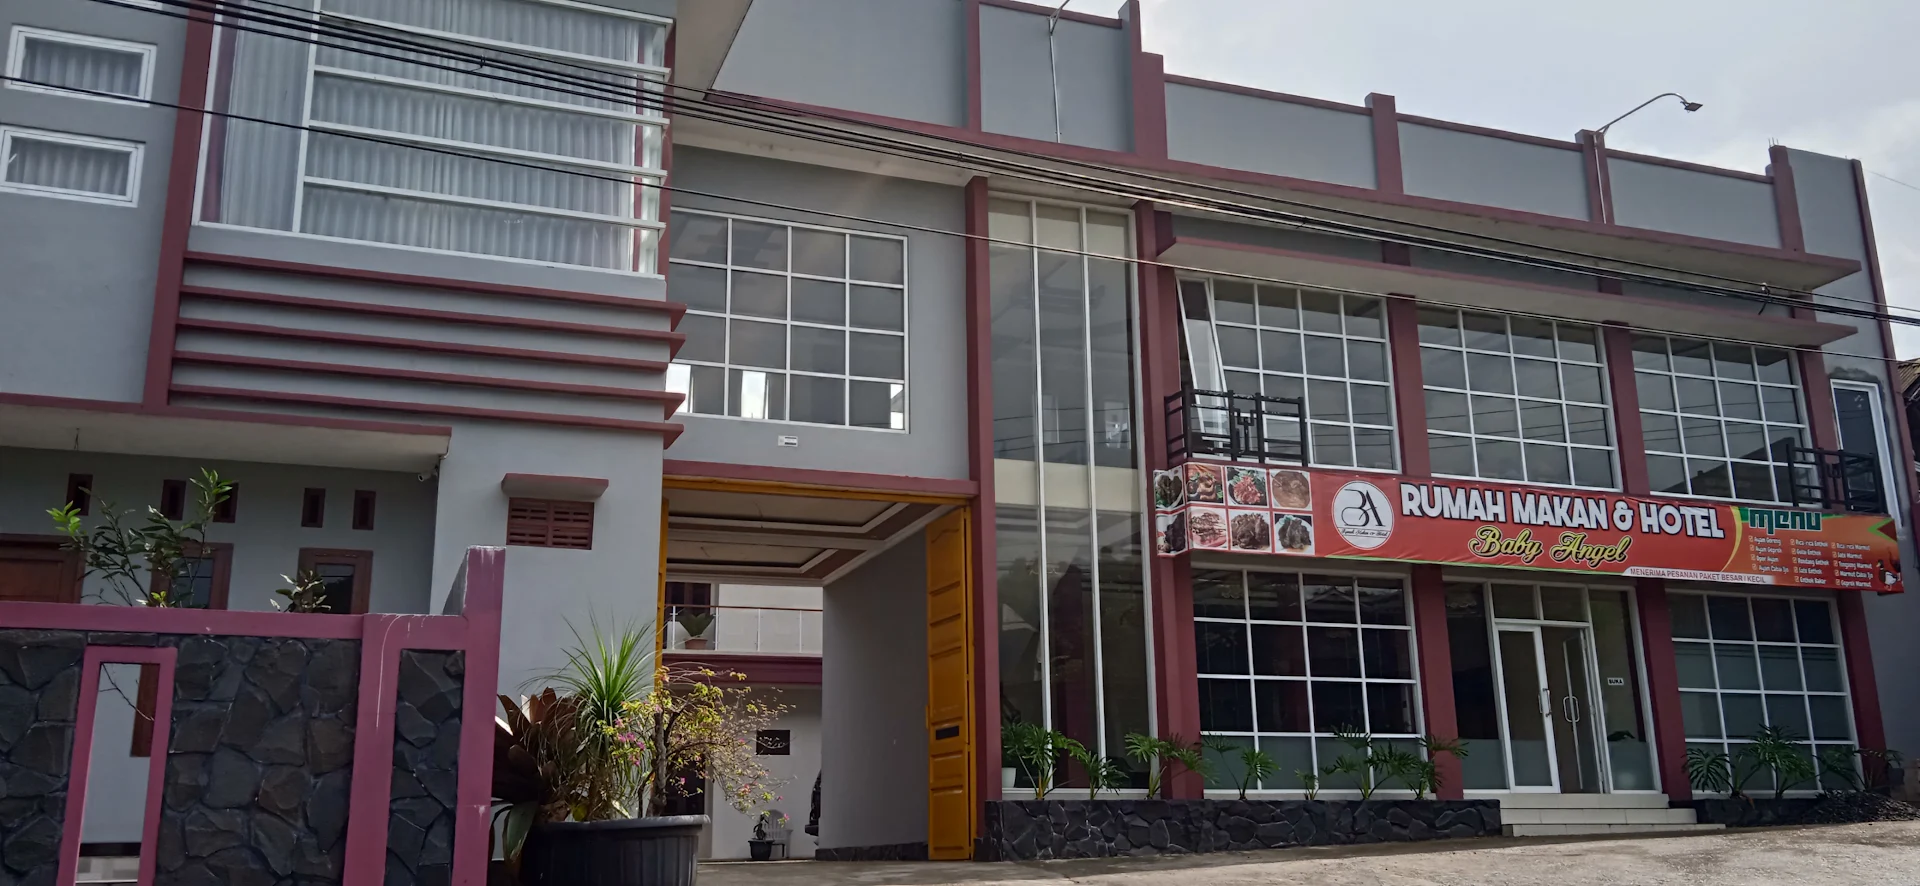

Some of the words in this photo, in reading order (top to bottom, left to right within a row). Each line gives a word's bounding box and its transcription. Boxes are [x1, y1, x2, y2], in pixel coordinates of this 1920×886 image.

[1400, 484, 1506, 523] RUMAH
[1511, 491, 1608, 530] MAKAN
[1613, 498, 1634, 531] &
[1638, 502, 1725, 538] HOTEL
[1468, 525, 1543, 563] Baby
[1549, 531, 1634, 568] Angel
[1630, 568, 1666, 577] MENERIMA
[1667, 570, 1698, 579] PESANAN
[1699, 572, 1720, 580] PAKET
[1721, 574, 1743, 582] BESAR
[1748, 575, 1766, 583] KECIL
